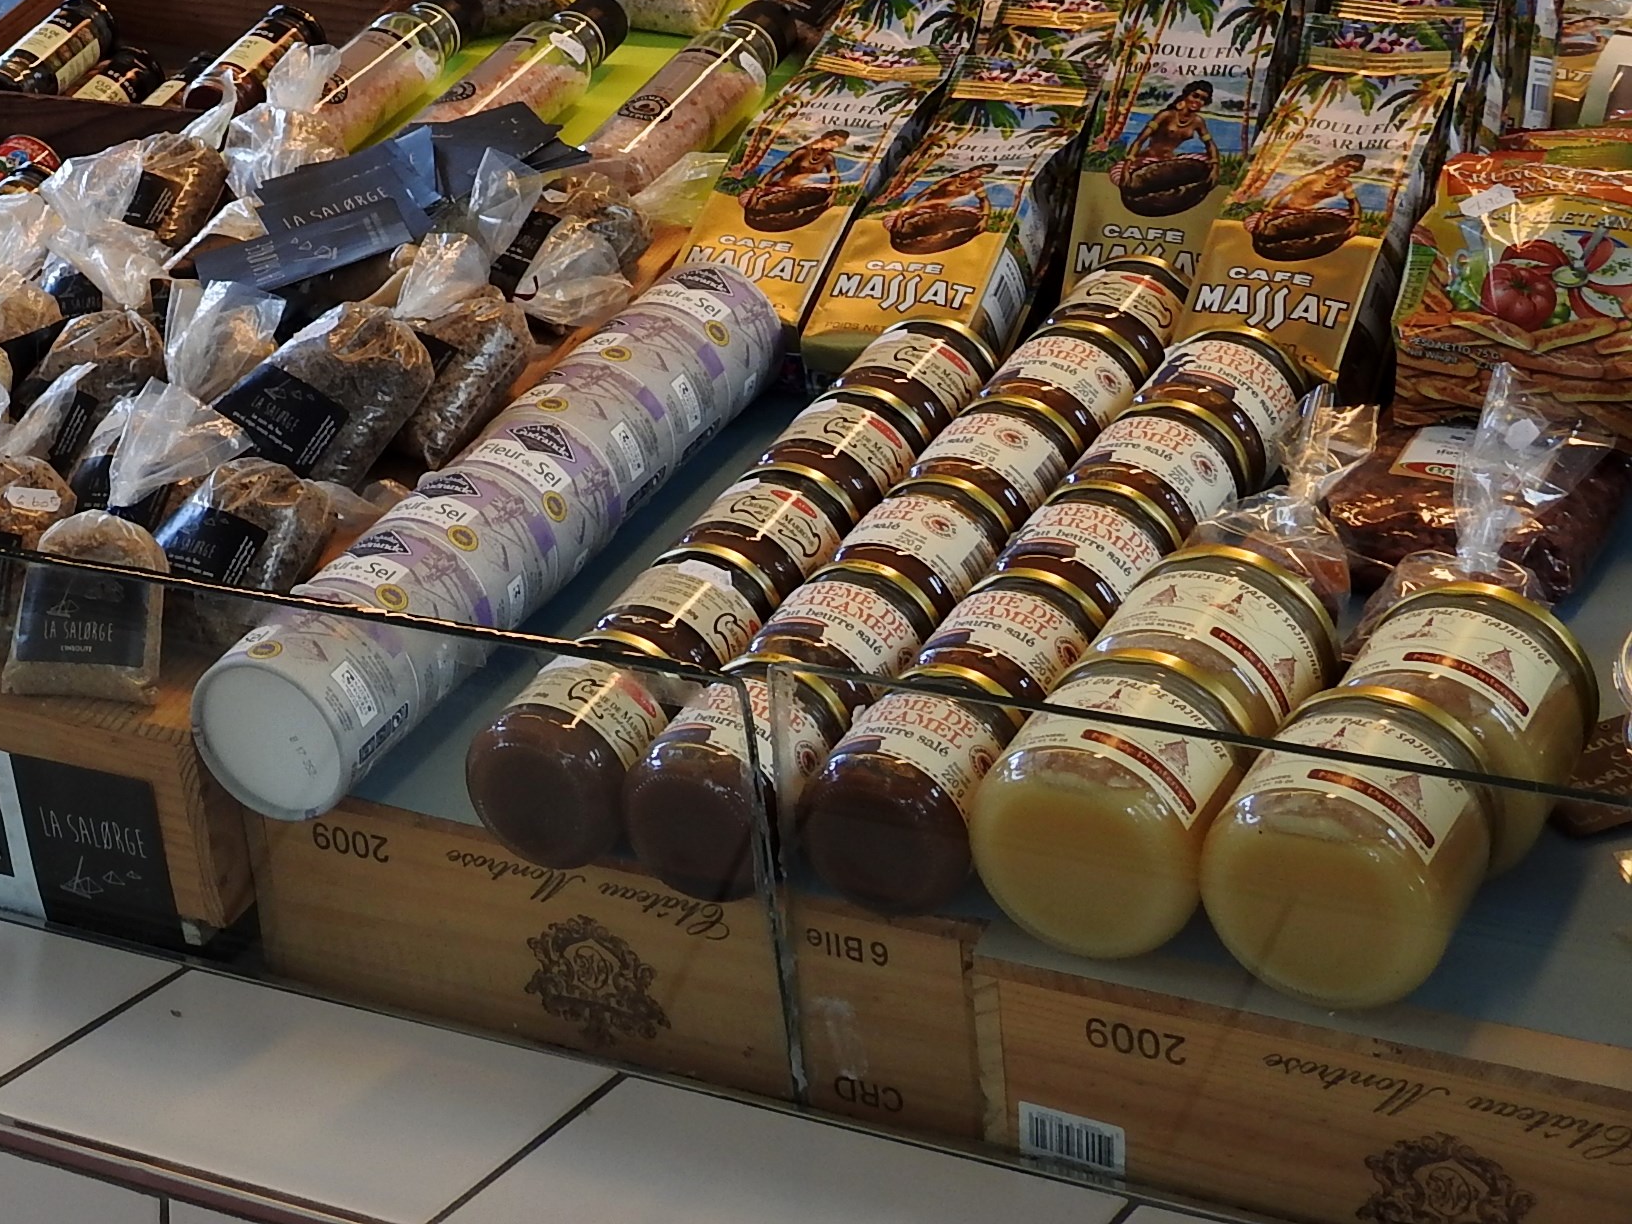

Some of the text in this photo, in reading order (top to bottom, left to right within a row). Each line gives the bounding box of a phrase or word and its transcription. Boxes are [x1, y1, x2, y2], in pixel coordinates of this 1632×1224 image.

[1142, 42, 1246, 60] MOULU FIN
[1171, 64, 1254, 78] ARABICA
[1300, 116, 1369, 136] MOULU
[1326, 135, 1412, 152] ARABICA
[693, 295, 722, 318] Sel
[830, 273, 976, 313] MASSAT
[1193, 284, 1351, 330] MASSAT
[533, 461, 562, 488] Sel
[434, 503, 467, 523] Sel
[1035, 516, 1142, 572] CARAMEL
[1055, 528, 1105, 553] beurre
[363, 561, 397, 582] Sel
[43, 620, 115, 644] LA SALØRGE
[804, 608, 855, 634] beurre
[942, 707, 982, 739] DE
[38, 805, 148, 860] LA SALØRGE
[310, 821, 392, 866] 2009
[444, 845, 588, 904] Montrose
[1085, 1015, 1188, 1067] 2009
[833, 1075, 905, 1113] CRD
[1262, 1052, 1452, 1118] Montrose
